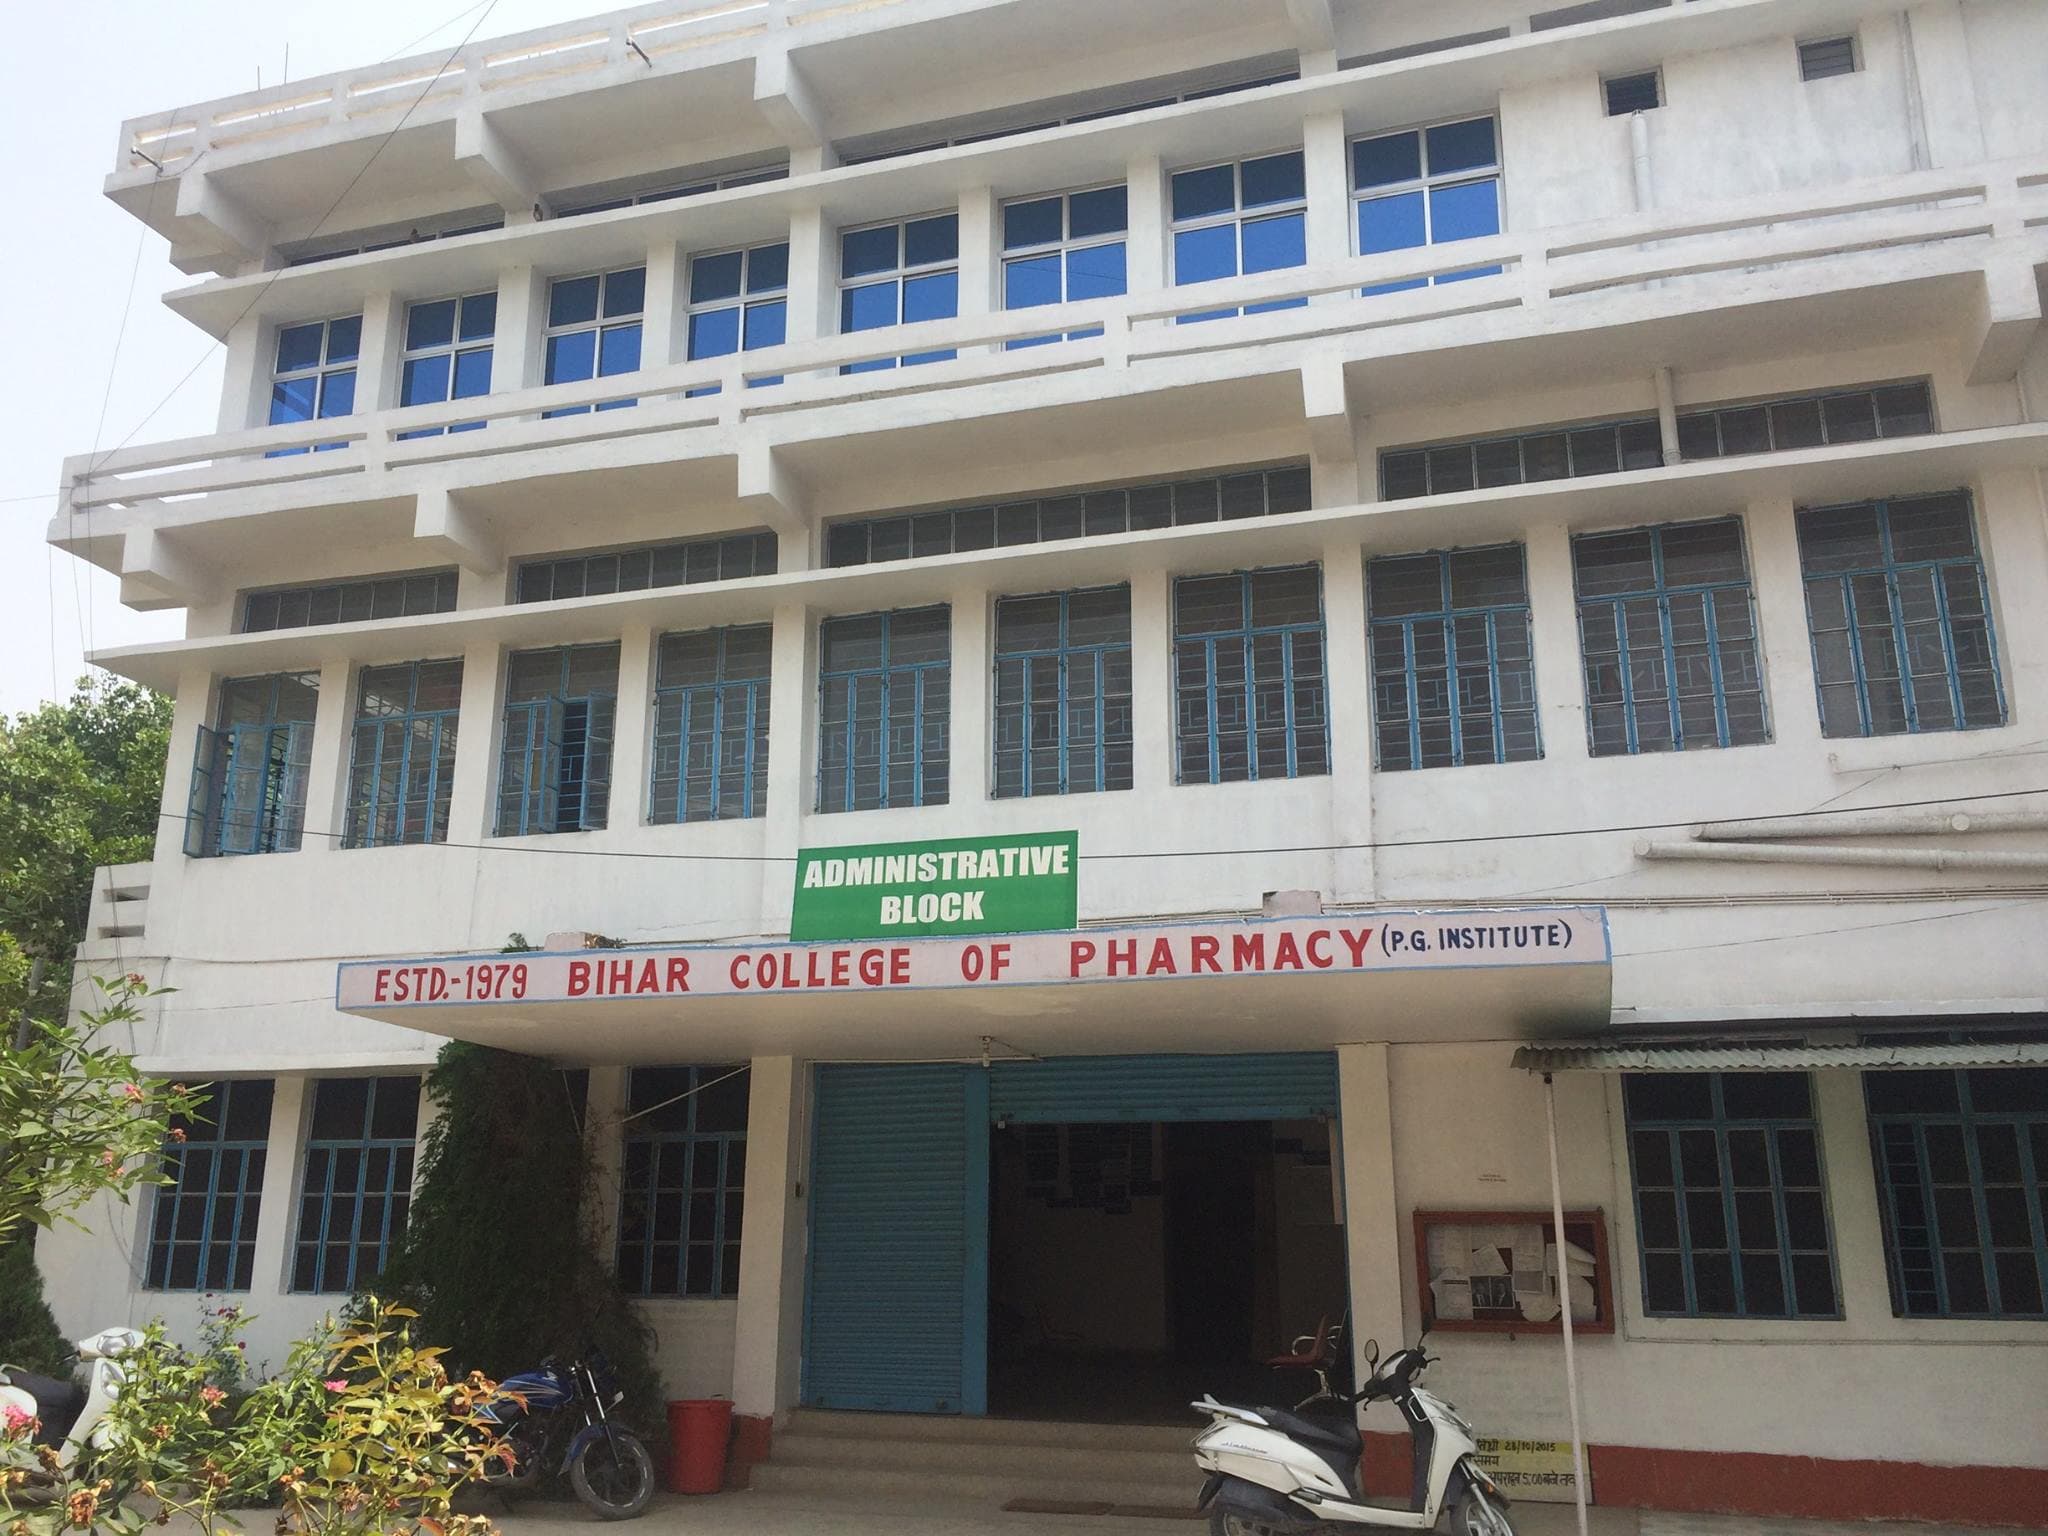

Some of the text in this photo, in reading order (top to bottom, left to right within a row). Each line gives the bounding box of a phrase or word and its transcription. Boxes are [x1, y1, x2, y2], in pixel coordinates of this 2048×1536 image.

[803, 844, 1069, 888] ADMINISTRATIVE
[880, 890, 985, 925] BLOCK
[374, 919, 1573, 1002] ESTD.-1979 BIHAR COLLEGE OF PHARMACY (P.G. INSTITUTE)
